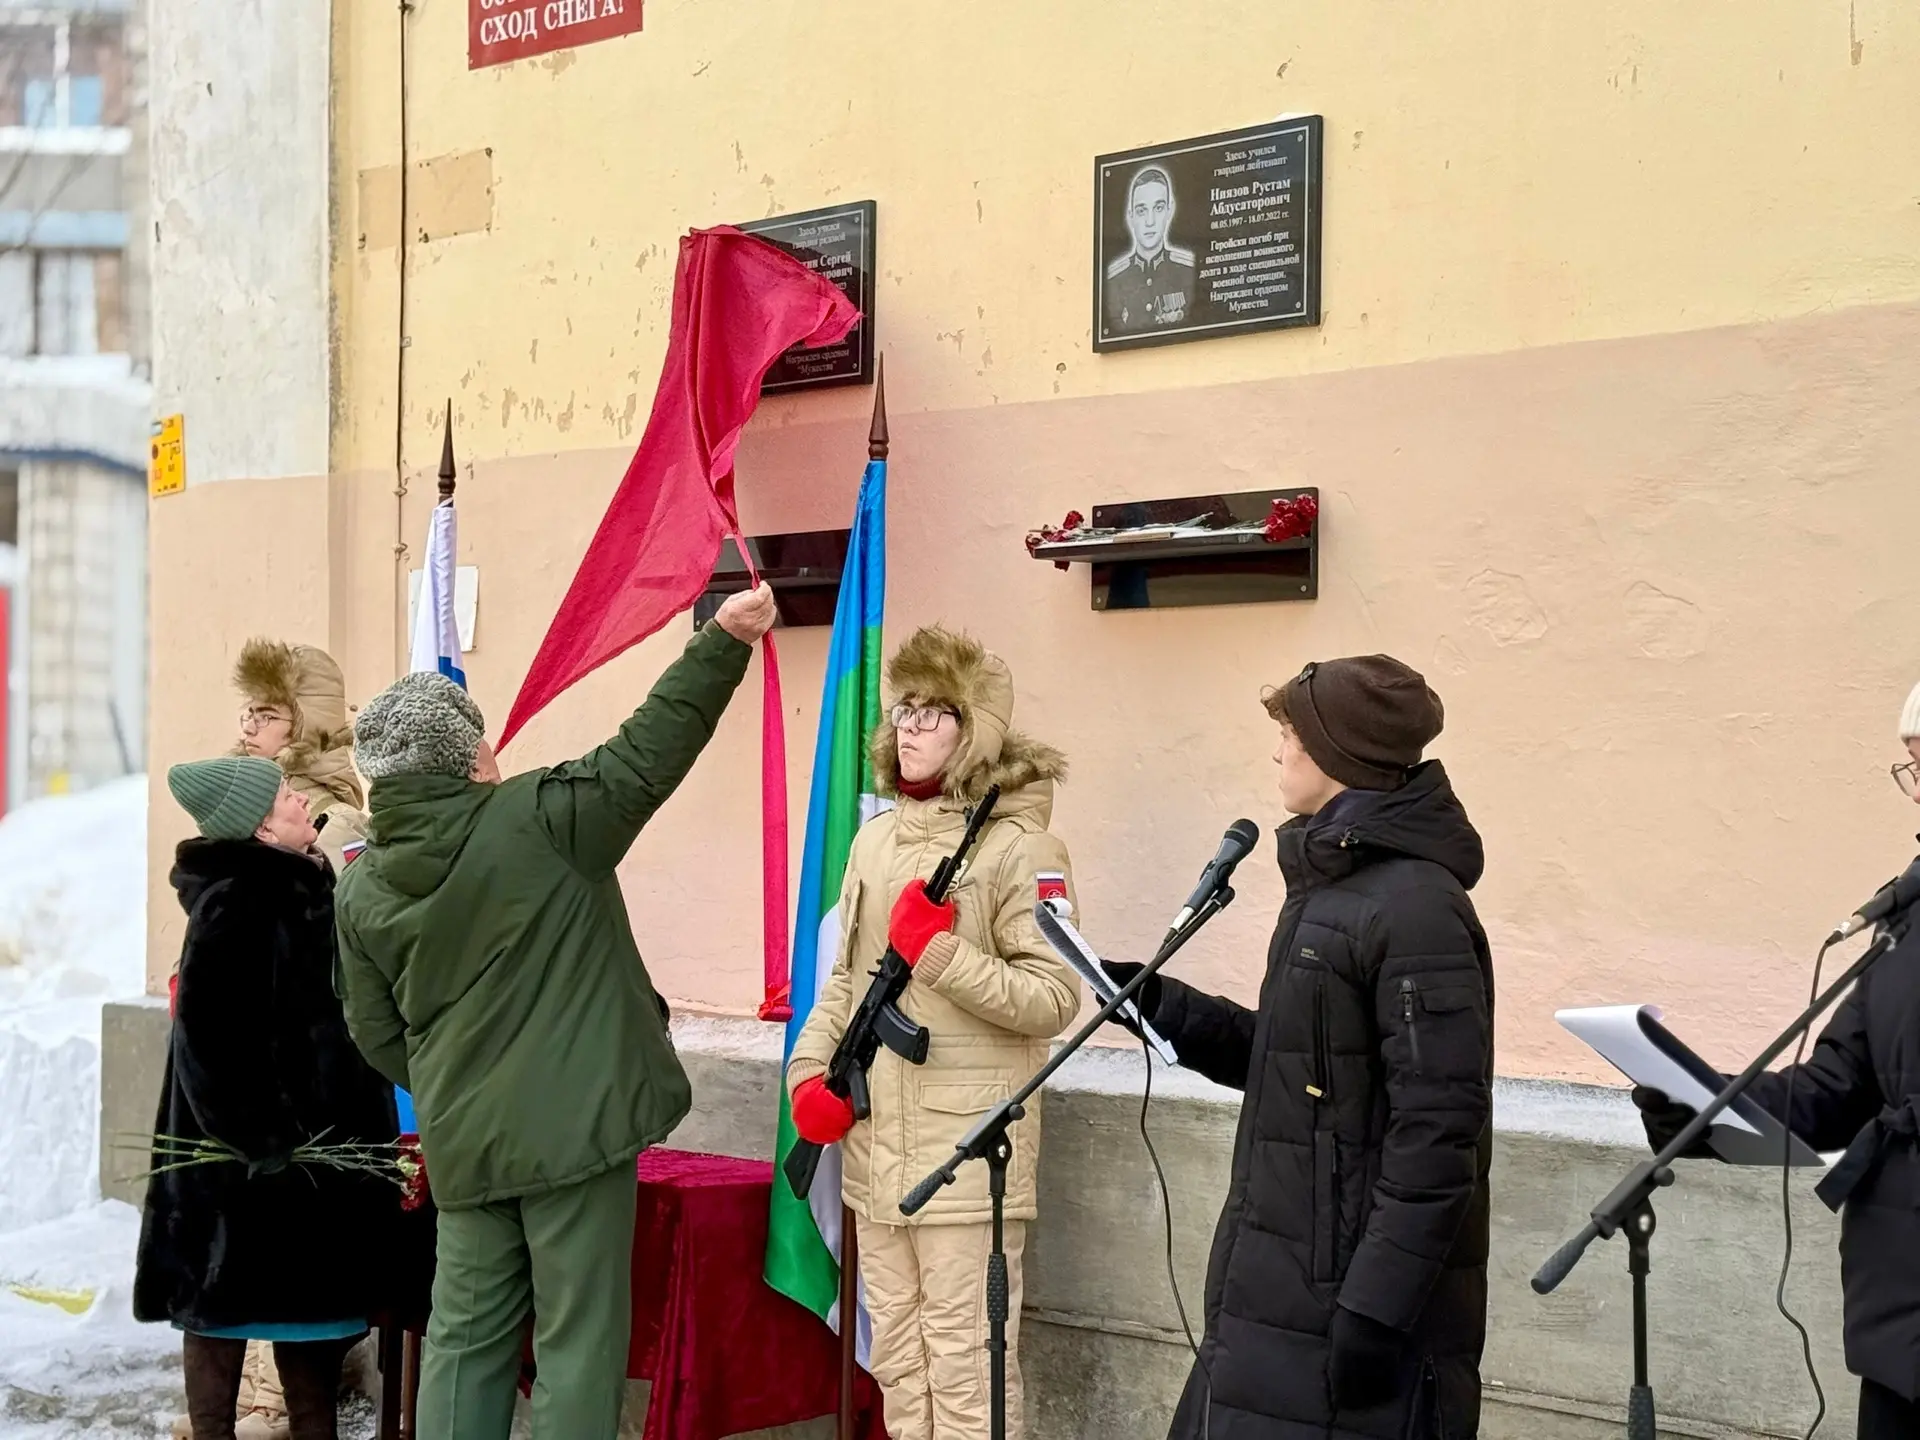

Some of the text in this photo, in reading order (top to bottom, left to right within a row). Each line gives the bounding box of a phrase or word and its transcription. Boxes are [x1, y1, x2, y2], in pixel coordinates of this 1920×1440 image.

[480, 0, 623, 45] СХОД СНЕГА!
[1225, 145, 1276, 161] Здесь учился
[1214, 157, 1288, 177] гвардии лейтенант
[1211, 179, 1290, 201] Ниязов Рустам
[1210, 194, 1290, 215] Абдусаторович
[1211, 231, 1289, 251] Геройски погиб при
[820, 250, 851, 268] Сергей
[1206, 244, 1294, 264] исполнении воинского
[1199, 267, 1221, 279] долга
[1229, 264, 1247, 273] ходе
[1249, 254, 1299, 270] специальной
[1213, 271, 1286, 288] военной операции.
[1210, 284, 1288, 302] Награжден орденом
[1229, 299, 1268, 313] Мужества
